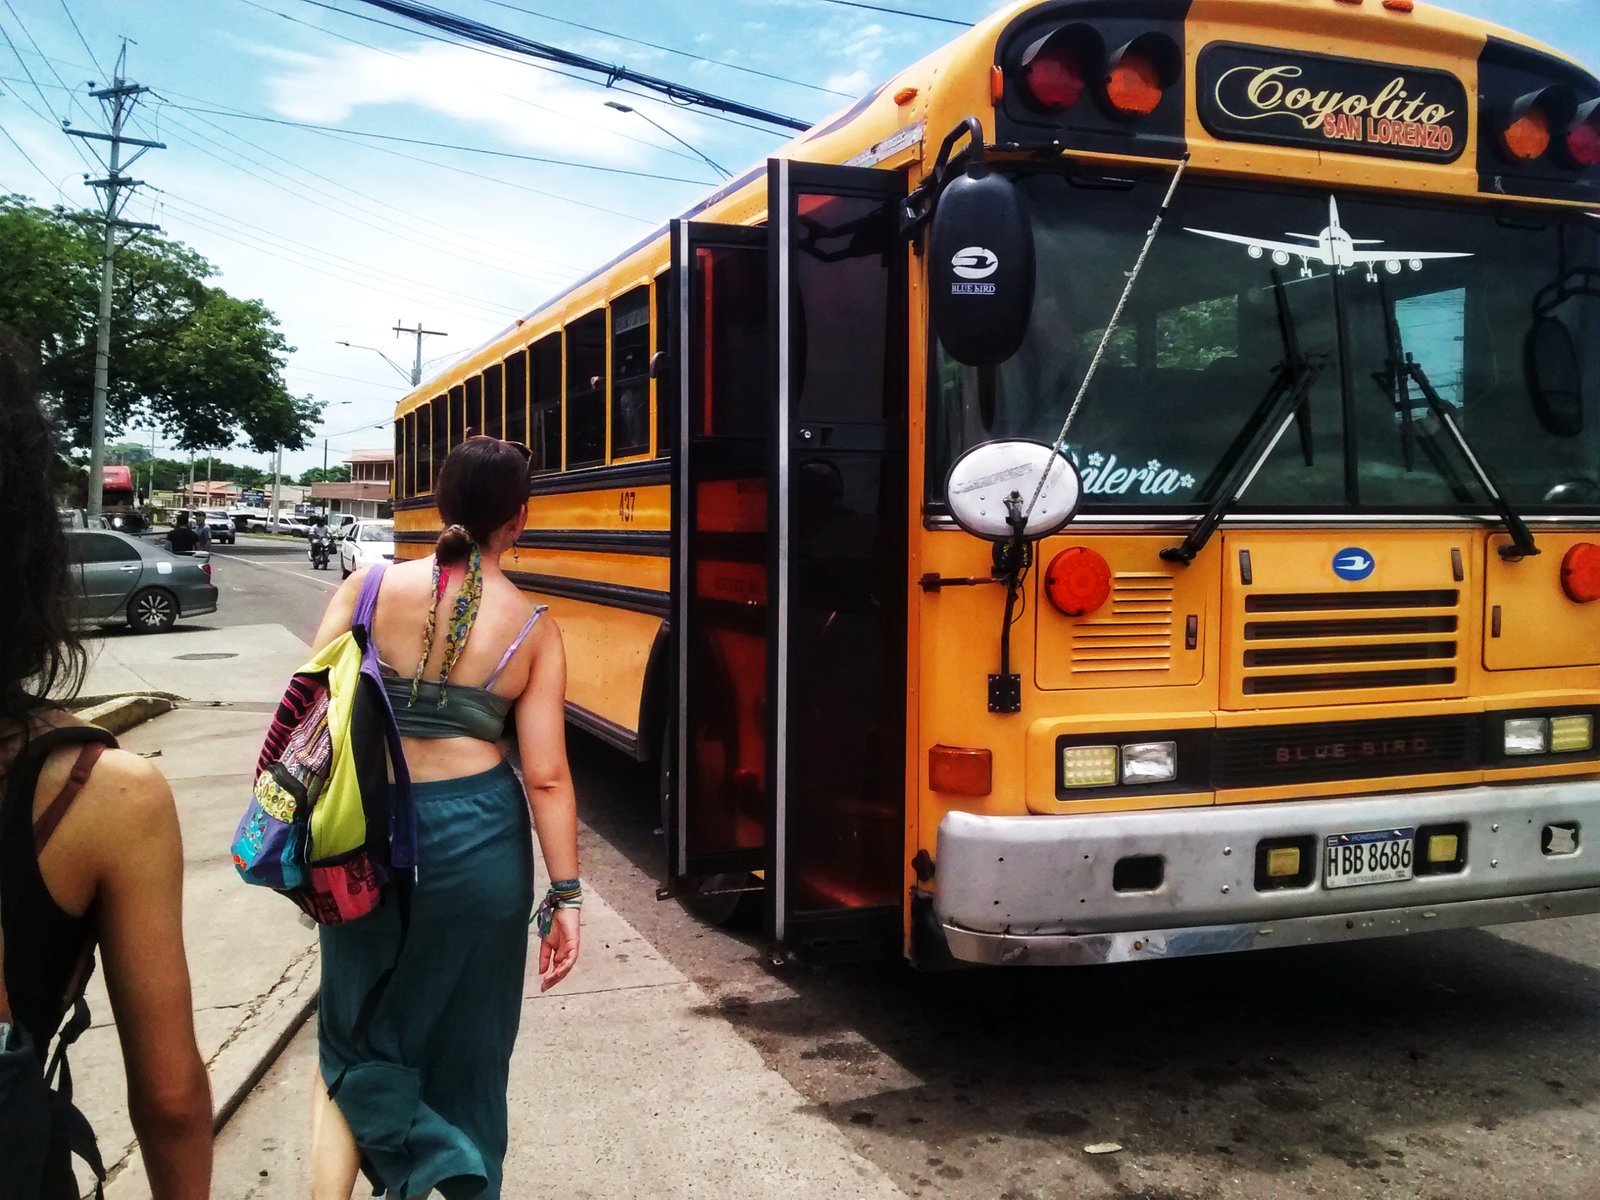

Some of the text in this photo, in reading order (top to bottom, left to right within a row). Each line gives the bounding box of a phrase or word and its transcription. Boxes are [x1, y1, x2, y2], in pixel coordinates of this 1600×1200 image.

[1215, 65, 1455, 129] Coyolito
[1322, 111, 1454, 151] SAN LORENZO
[1071, 452, 1181, 494] aleria
[619, 491, 636, 522] 437
[1276, 738, 1427, 762] BLUE BIRD
